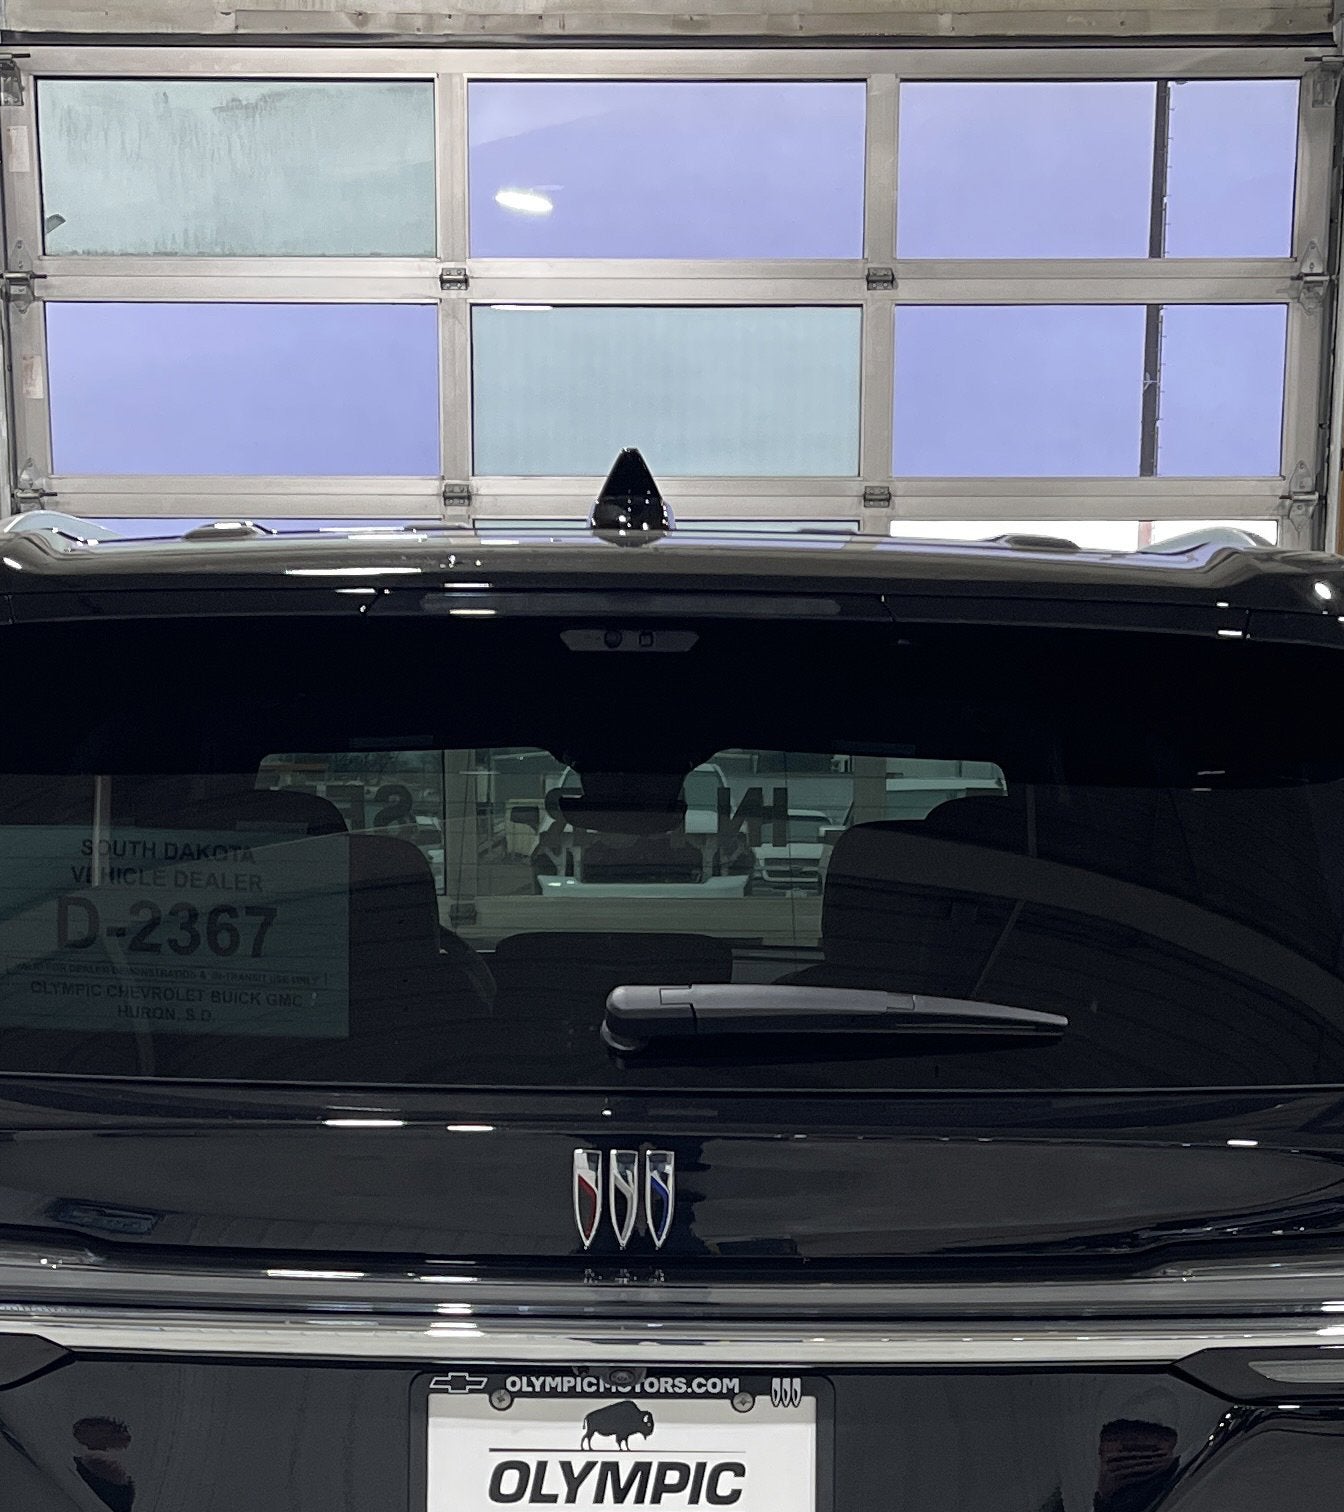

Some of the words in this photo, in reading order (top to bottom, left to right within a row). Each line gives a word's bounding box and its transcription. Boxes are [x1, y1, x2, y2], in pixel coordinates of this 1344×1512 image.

[81, 839, 156, 859] SOUTH
[164, 842, 256, 864] DAKOTA
[174, 870, 263, 893] DEALER
[57, 896, 278, 957] D-2367
[30, 980, 102, 998] OLYMPIC
[106, 983, 203, 1003] CHEVROLET
[210, 989, 262, 1006] BUICK
[265, 992, 304, 1008] GMC
[488, 1460, 746, 1506] OLYMPIC
